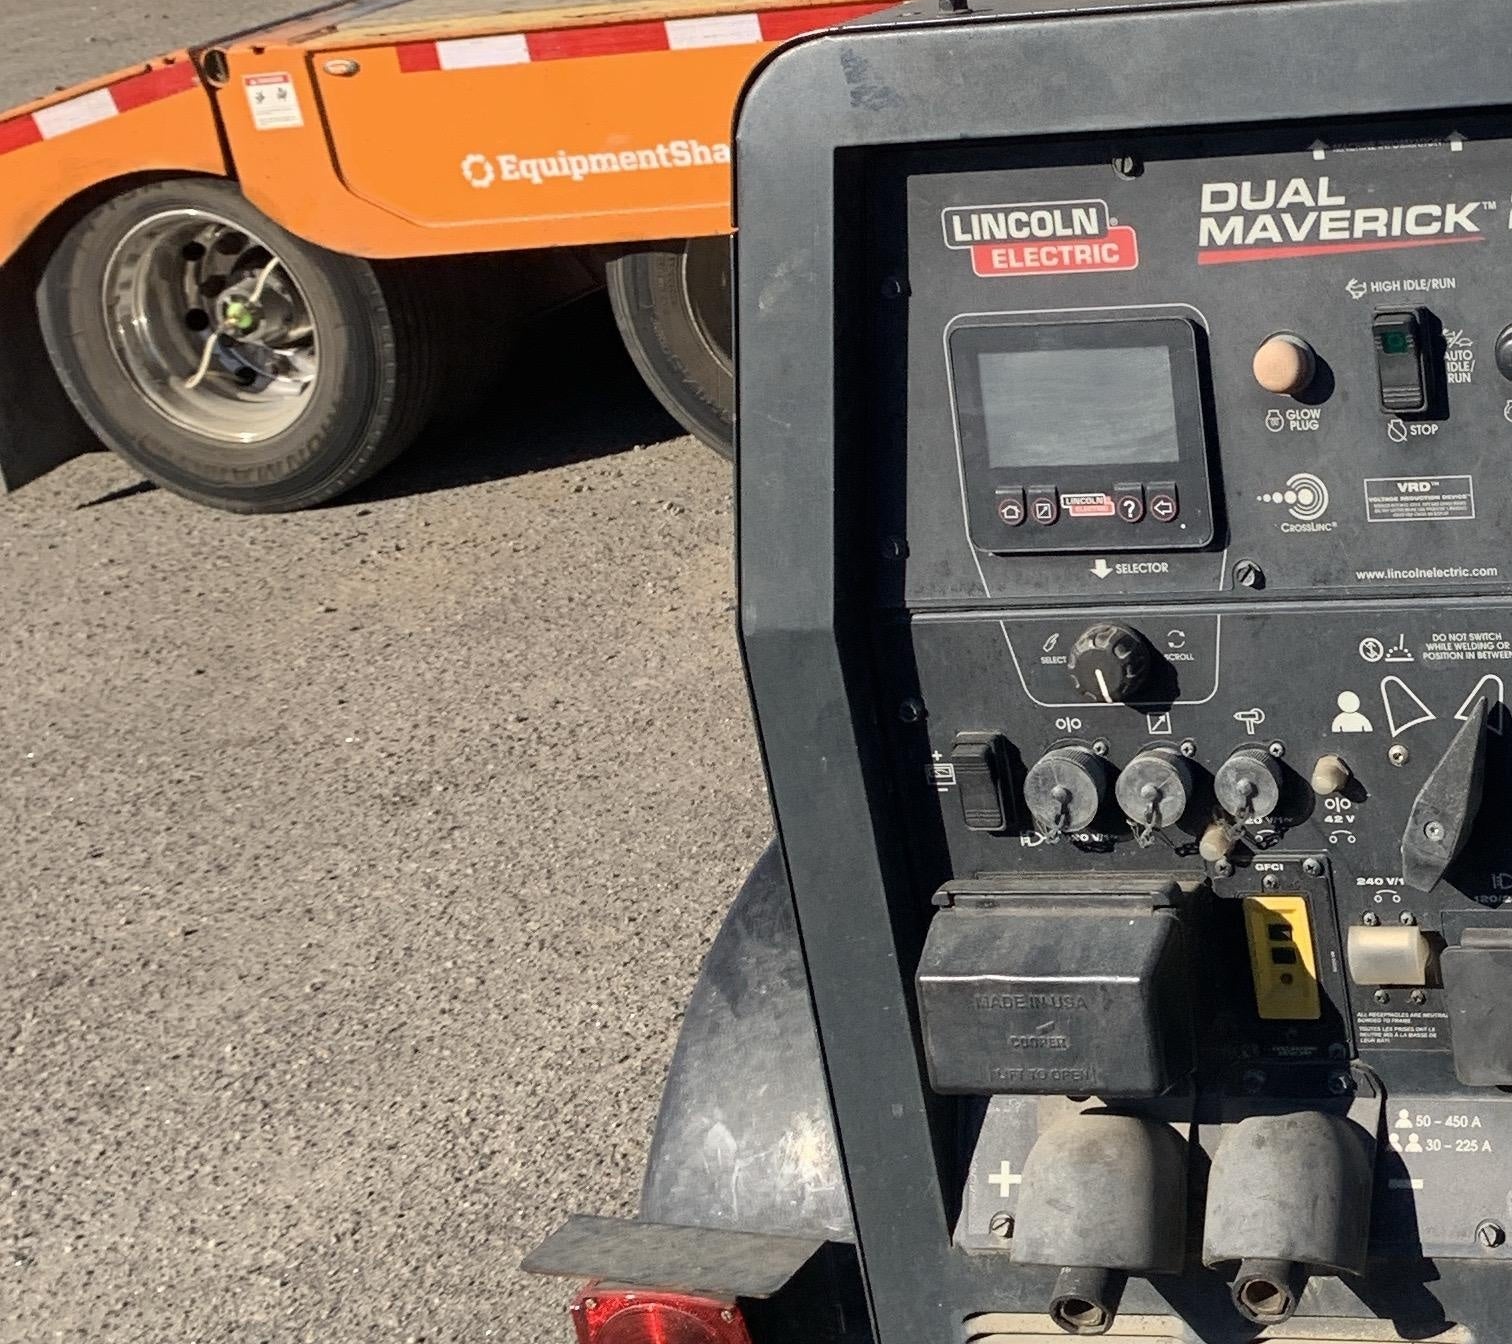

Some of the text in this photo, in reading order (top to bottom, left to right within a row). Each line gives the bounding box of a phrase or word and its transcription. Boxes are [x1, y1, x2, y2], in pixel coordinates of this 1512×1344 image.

[1200, 176, 1346, 213] DUAL
[952, 207, 1100, 242] LINCOLN
[991, 243, 1121, 269] ELECTRIC
[1370, 277, 1456, 293] HIGH IDLE/RUN
[1445, 349, 1474, 361] AUTO
[1447, 372, 1472, 384] RUN
[1286, 409, 1321, 421] GLOW
[1290, 419, 1319, 432] PLUG
[1410, 423, 1439, 436] STOP
[1066, 496, 1105, 505] LINCOLN
[1115, 562, 1169, 574] SELECTOR
[1356, 565, 1498, 580] www.lincolnelectric.com
[1432, 632, 1503, 642] DO NOT SWITCH
[1425, 641, 1511, 652] WHILE WELDING OR
[1040, 655, 1067, 664] SELECT
[1164, 652, 1195, 662] SCROLL
[1423, 651, 1464, 661] POSITION
[1466, 651, 1476, 660] IN
[1324, 814, 1356, 824] 42 V
[1255, 863, 1284, 872] GFCI
[1356, 877, 1383, 886] 240
[975, 994, 1088, 1009] MADE IN USA
[1009, 1035, 1070, 1050] COOPER
[1415, 1115, 1431, 1128] 50
[1446, 1115, 1469, 1128] 450
[1470, 1115, 1482, 1128] A
[1425, 1139, 1442, 1152] 30
[1455, 1139, 1479, 1153] 225
[1481, 1139, 1492, 1152] A
